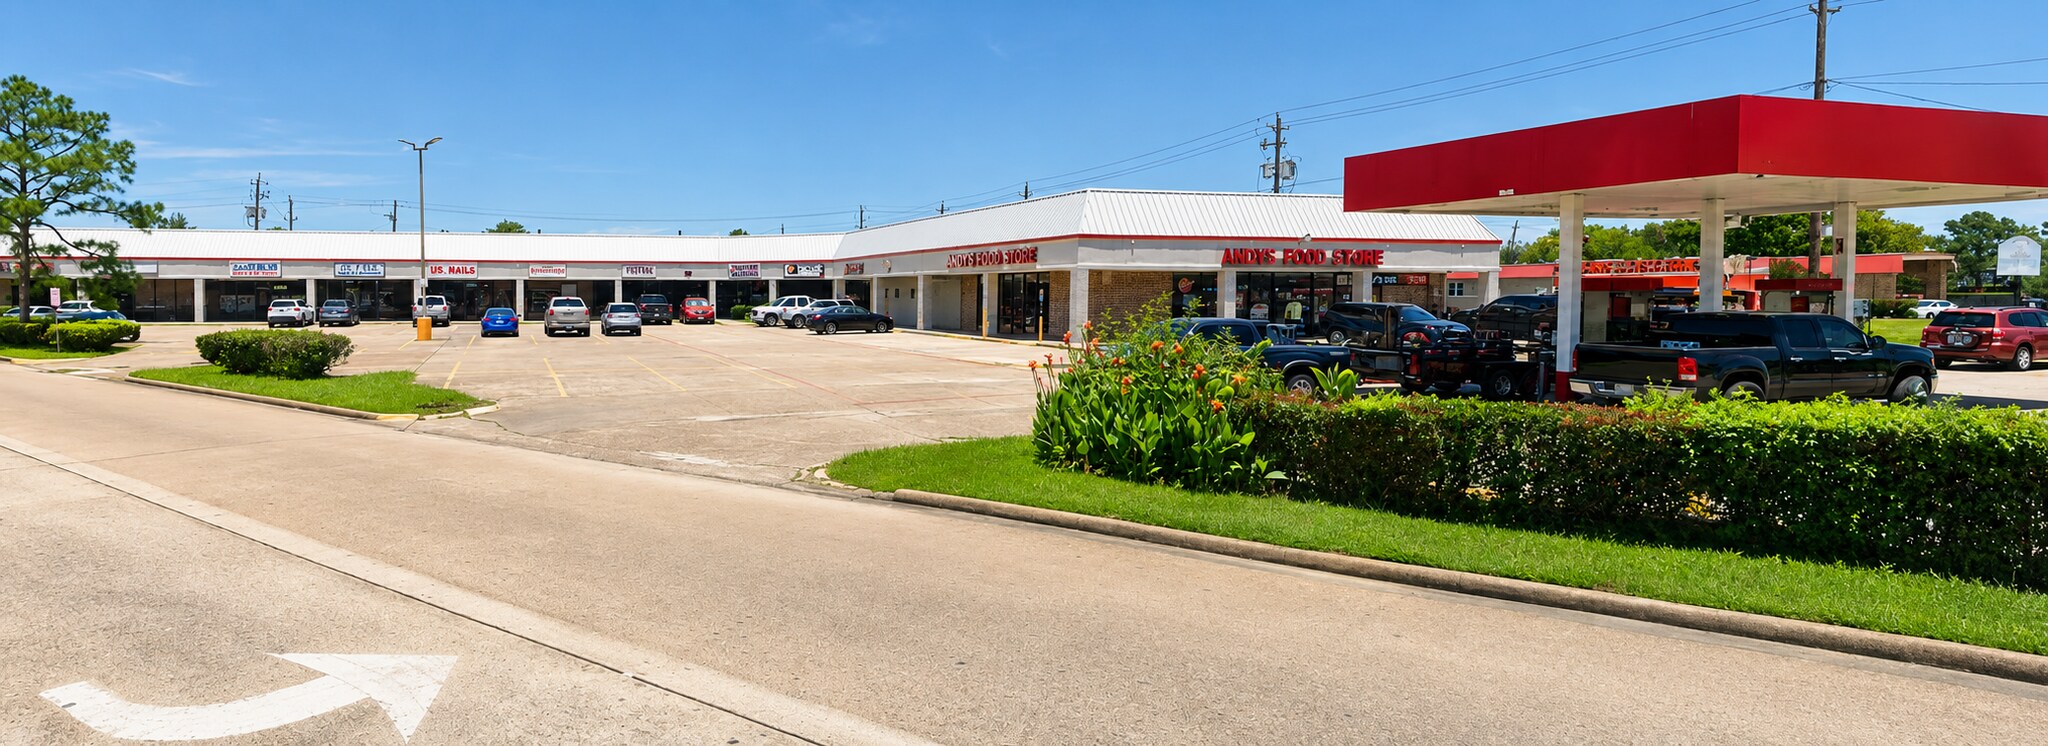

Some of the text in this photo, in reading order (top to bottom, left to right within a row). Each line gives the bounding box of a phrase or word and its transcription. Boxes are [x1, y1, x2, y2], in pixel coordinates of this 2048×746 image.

[976, 249, 1003, 266] FOOD
[1004, 246, 1038, 264] STORE
[1283, 248, 1326, 265] FOOD
[1332, 249, 1384, 266] STORE
[449, 265, 476, 275] NAILS
